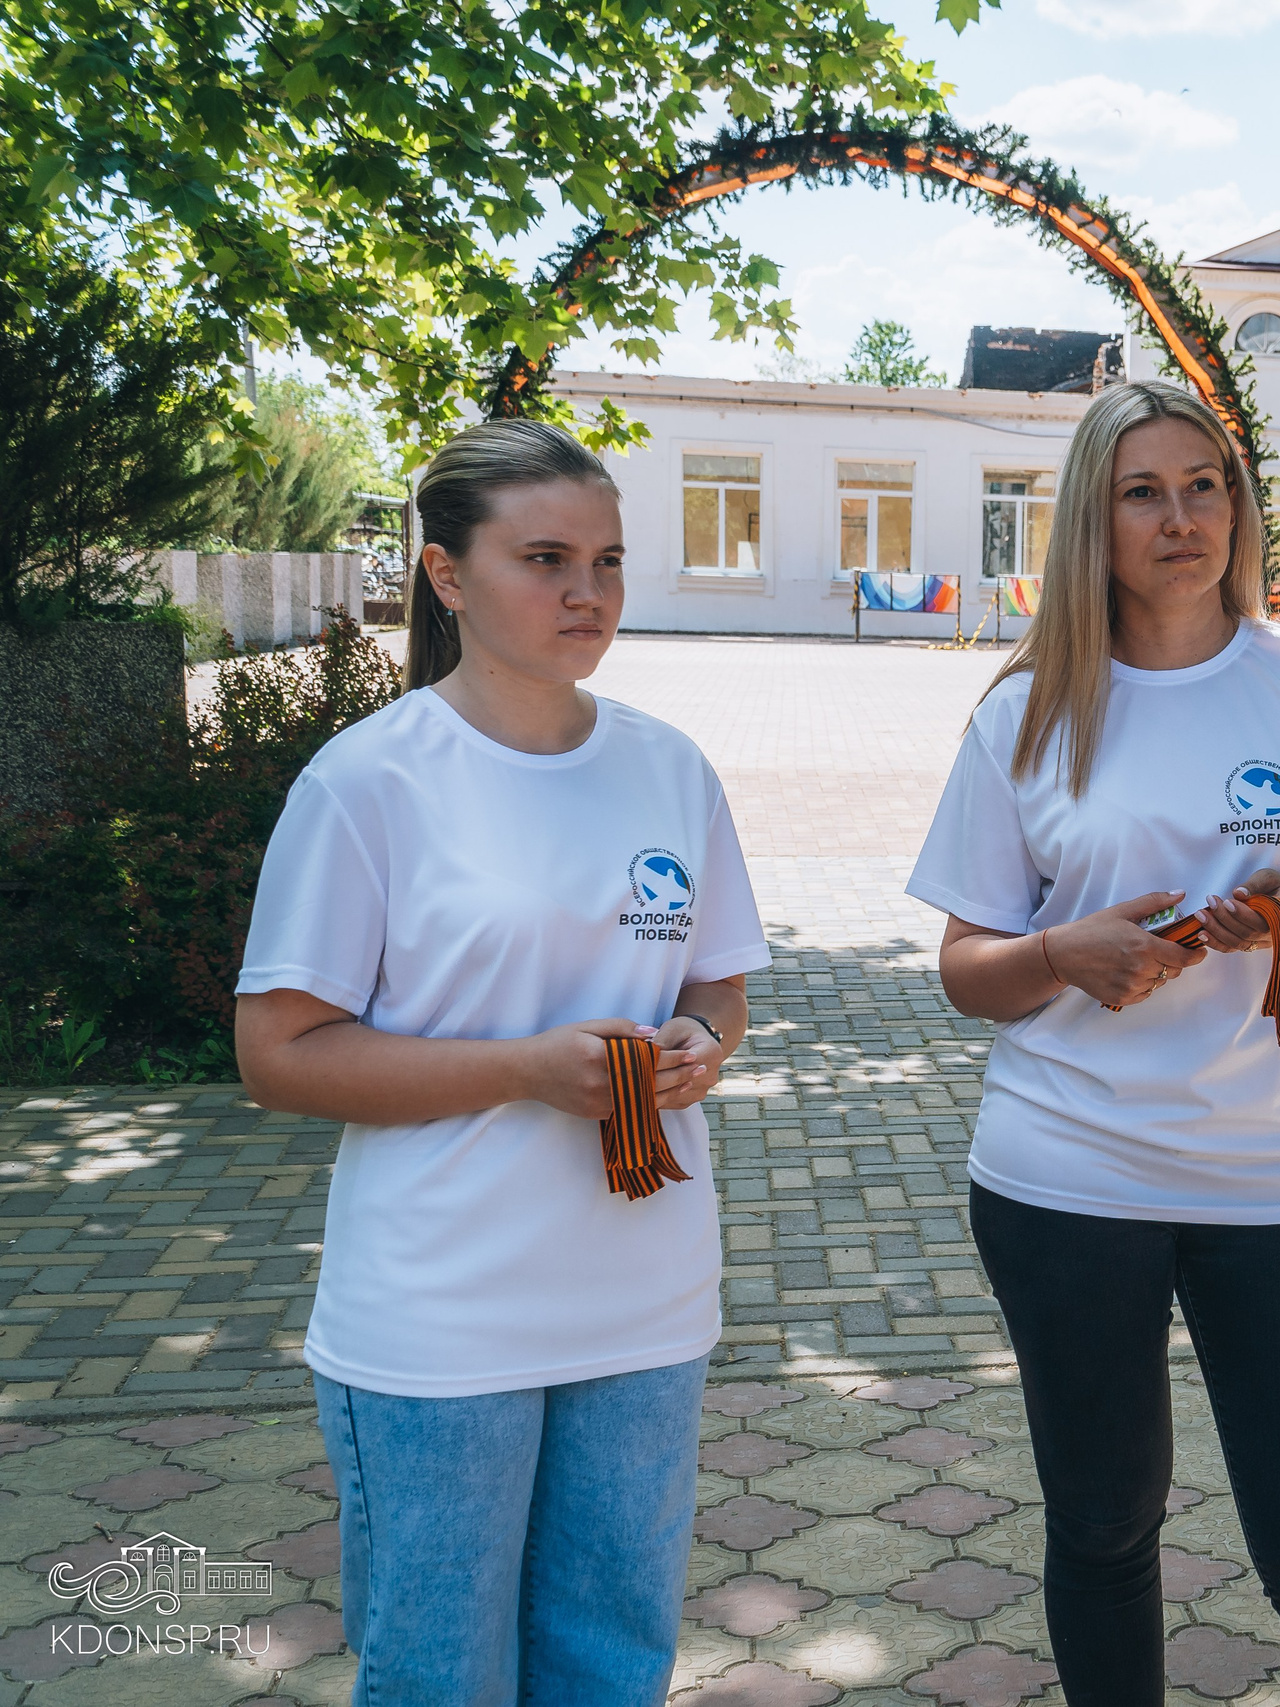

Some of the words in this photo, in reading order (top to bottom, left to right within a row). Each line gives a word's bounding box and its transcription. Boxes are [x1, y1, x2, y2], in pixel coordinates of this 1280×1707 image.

[1225, 766, 1242, 816] ВСЕРОССИЙСКОЕ
[627, 853, 646, 908] ВСЕРОССИЙСКОЕ
[619, 912, 694, 928] ВОЛОНТЁР
